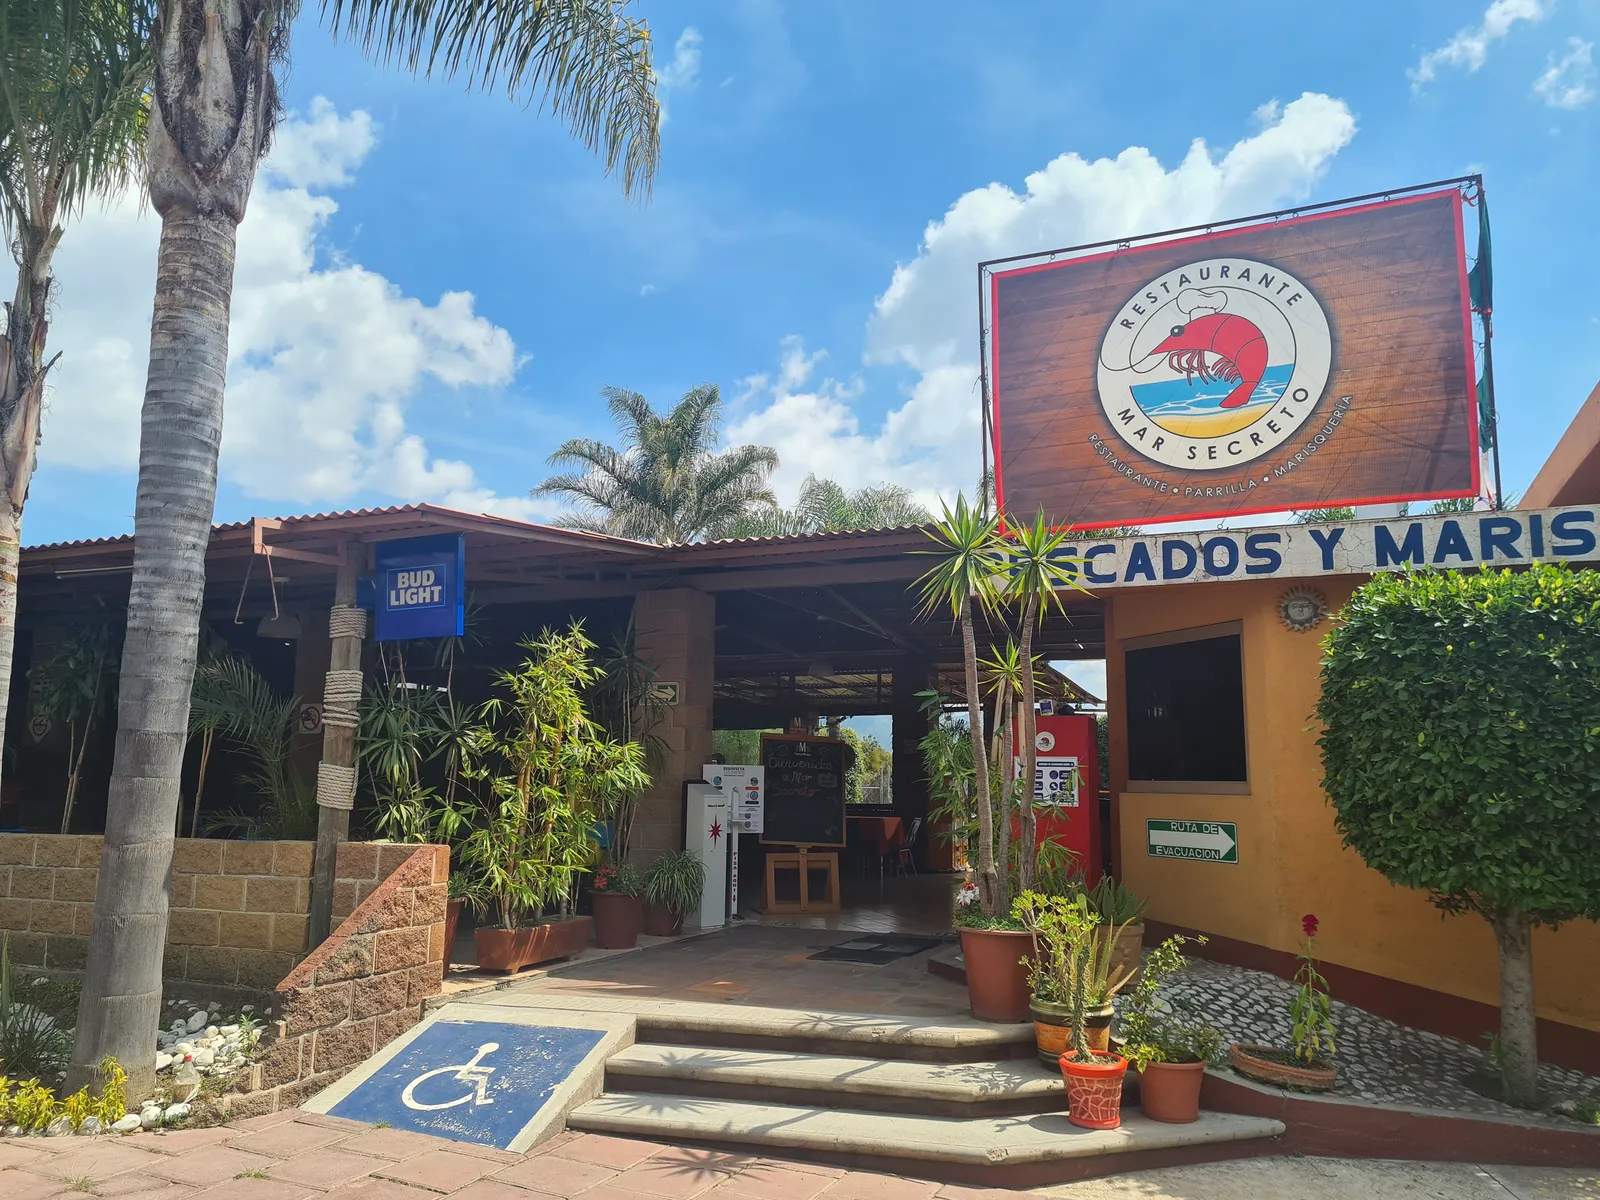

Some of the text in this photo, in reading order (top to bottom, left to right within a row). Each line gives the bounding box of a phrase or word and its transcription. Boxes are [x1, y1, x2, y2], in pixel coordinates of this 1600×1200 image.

[1119, 265, 1303, 330] RESTAURANTE
[1117, 387, 1309, 461] MAR SECRETO
[1088, 394, 1353, 498] RESTAURANTE PARRILLA MARISQUERÍA
[1308, 527, 1345, 571] Y
[1374, 510, 1597, 567] MARIS
[390, 585, 442, 606] LIGHT
[397, 569, 435, 589] BUD
[1170, 822, 1218, 834] RUTA DE
[1155, 845, 1219, 860] EVACUACION
